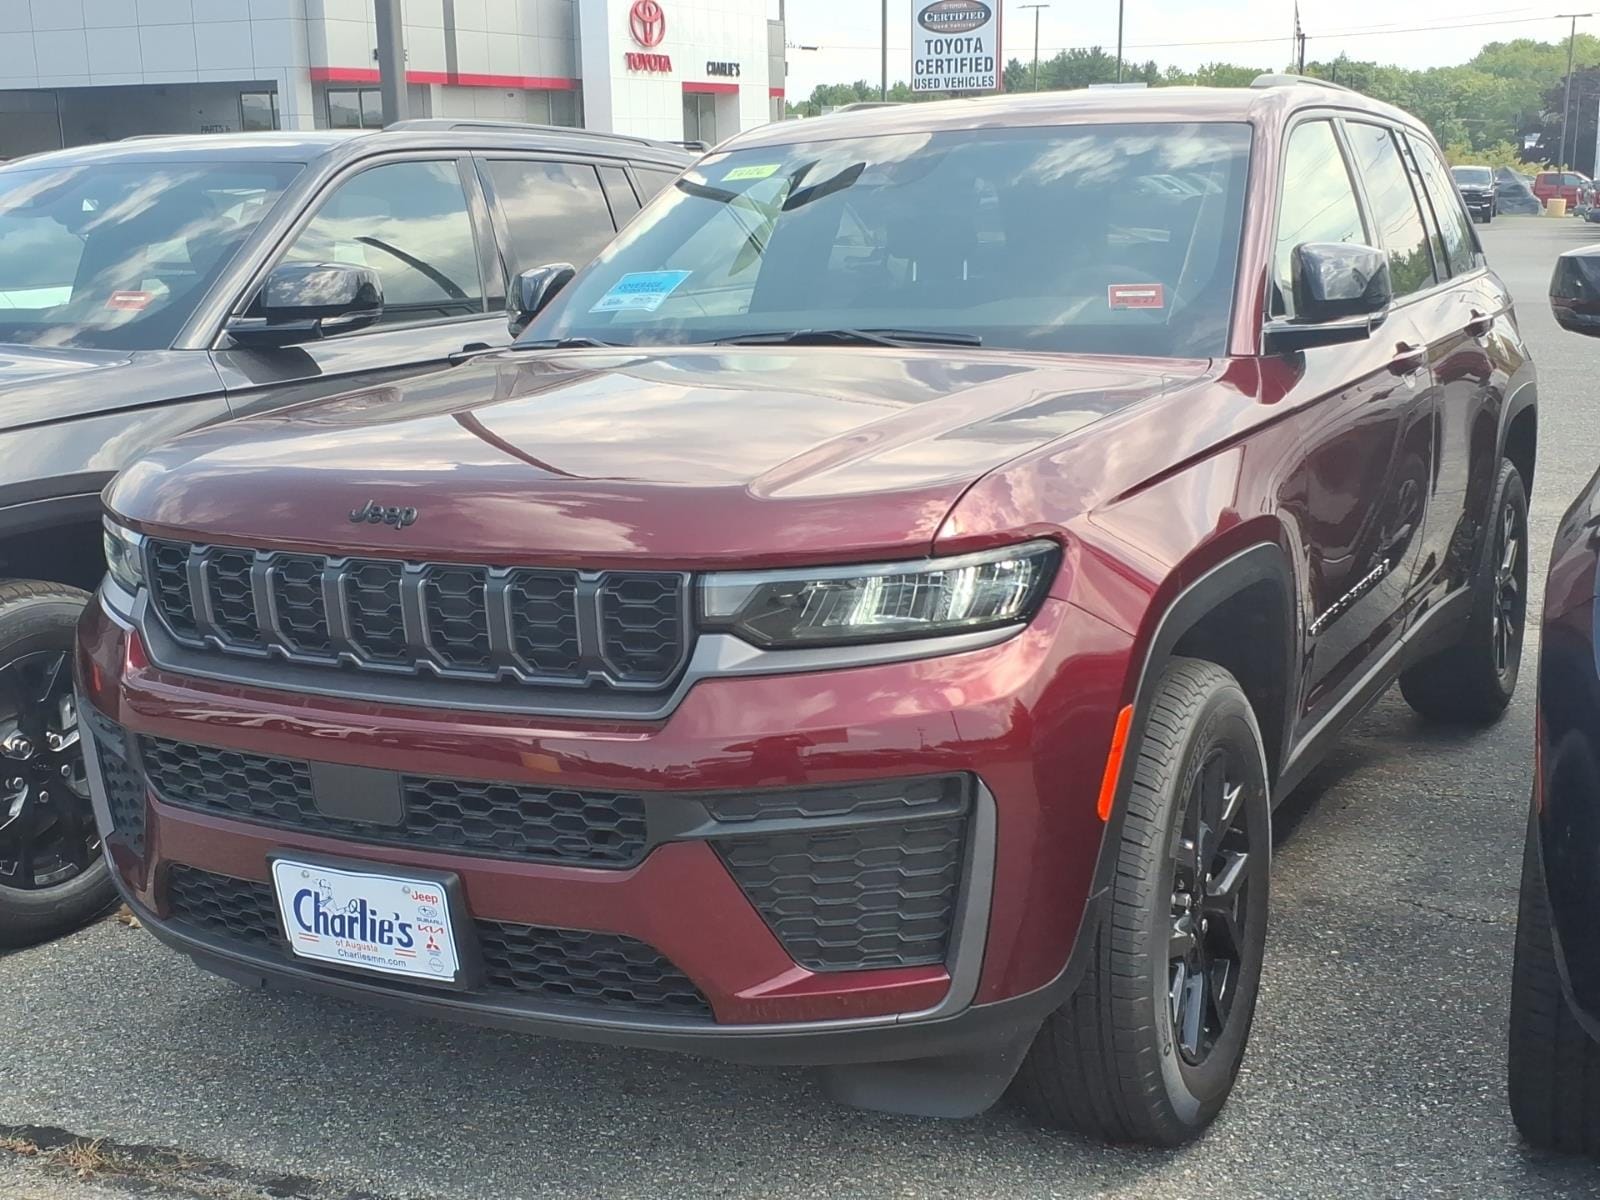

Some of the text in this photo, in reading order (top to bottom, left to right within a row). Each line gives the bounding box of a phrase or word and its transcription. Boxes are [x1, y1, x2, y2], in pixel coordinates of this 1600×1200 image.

[924, 11, 985, 22] CERTIFIED
[925, 37, 983, 55] TOYOTA
[625, 52, 673, 73] TOYOTA
[706, 60, 741, 77] CHARLIE'S
[915, 56, 993, 75] CERTIFIED
[914, 76, 994, 89] USED VEHICLES
[348, 499, 418, 531] Jeep
[411, 890, 439, 905] Jeep
[293, 888, 414, 948] Charlie's
[416, 916, 443, 926] SUBARU
[335, 939, 378, 953] of Augusta
[337, 948, 407, 967] Charliesmm.com
